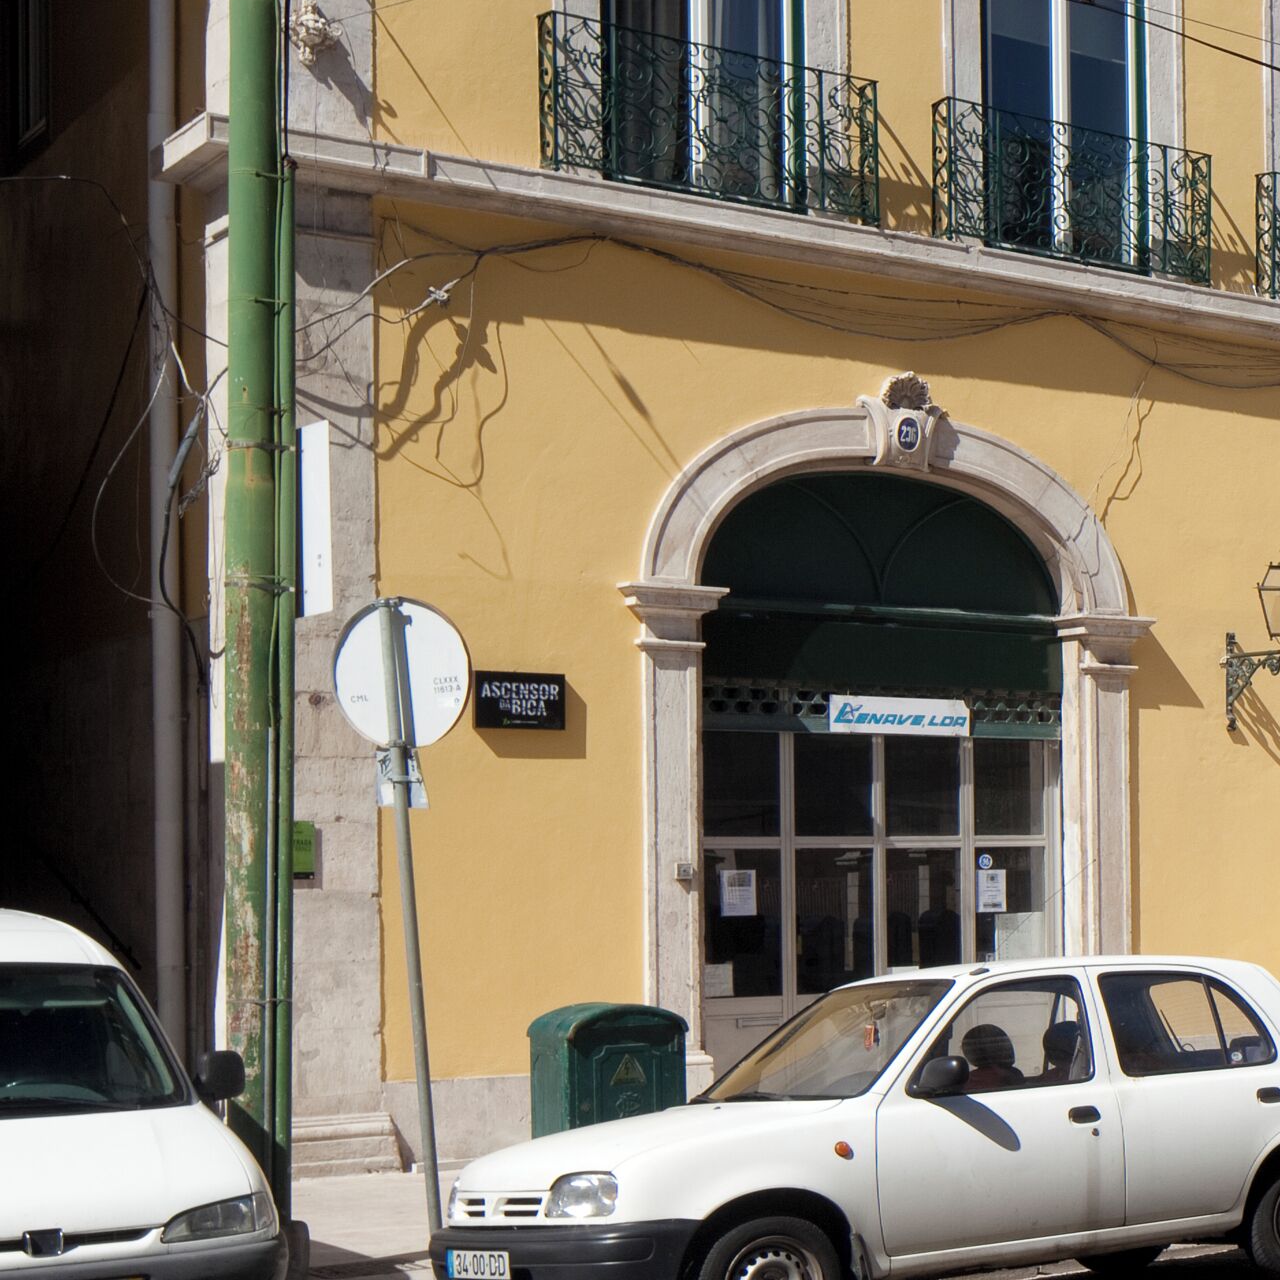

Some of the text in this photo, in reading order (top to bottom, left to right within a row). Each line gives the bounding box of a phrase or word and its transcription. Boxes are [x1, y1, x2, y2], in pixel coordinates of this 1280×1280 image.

[350, 694, 369, 703] CML
[481, 681, 559, 700] ASCENSOR
[511, 699, 547, 716] BICA
